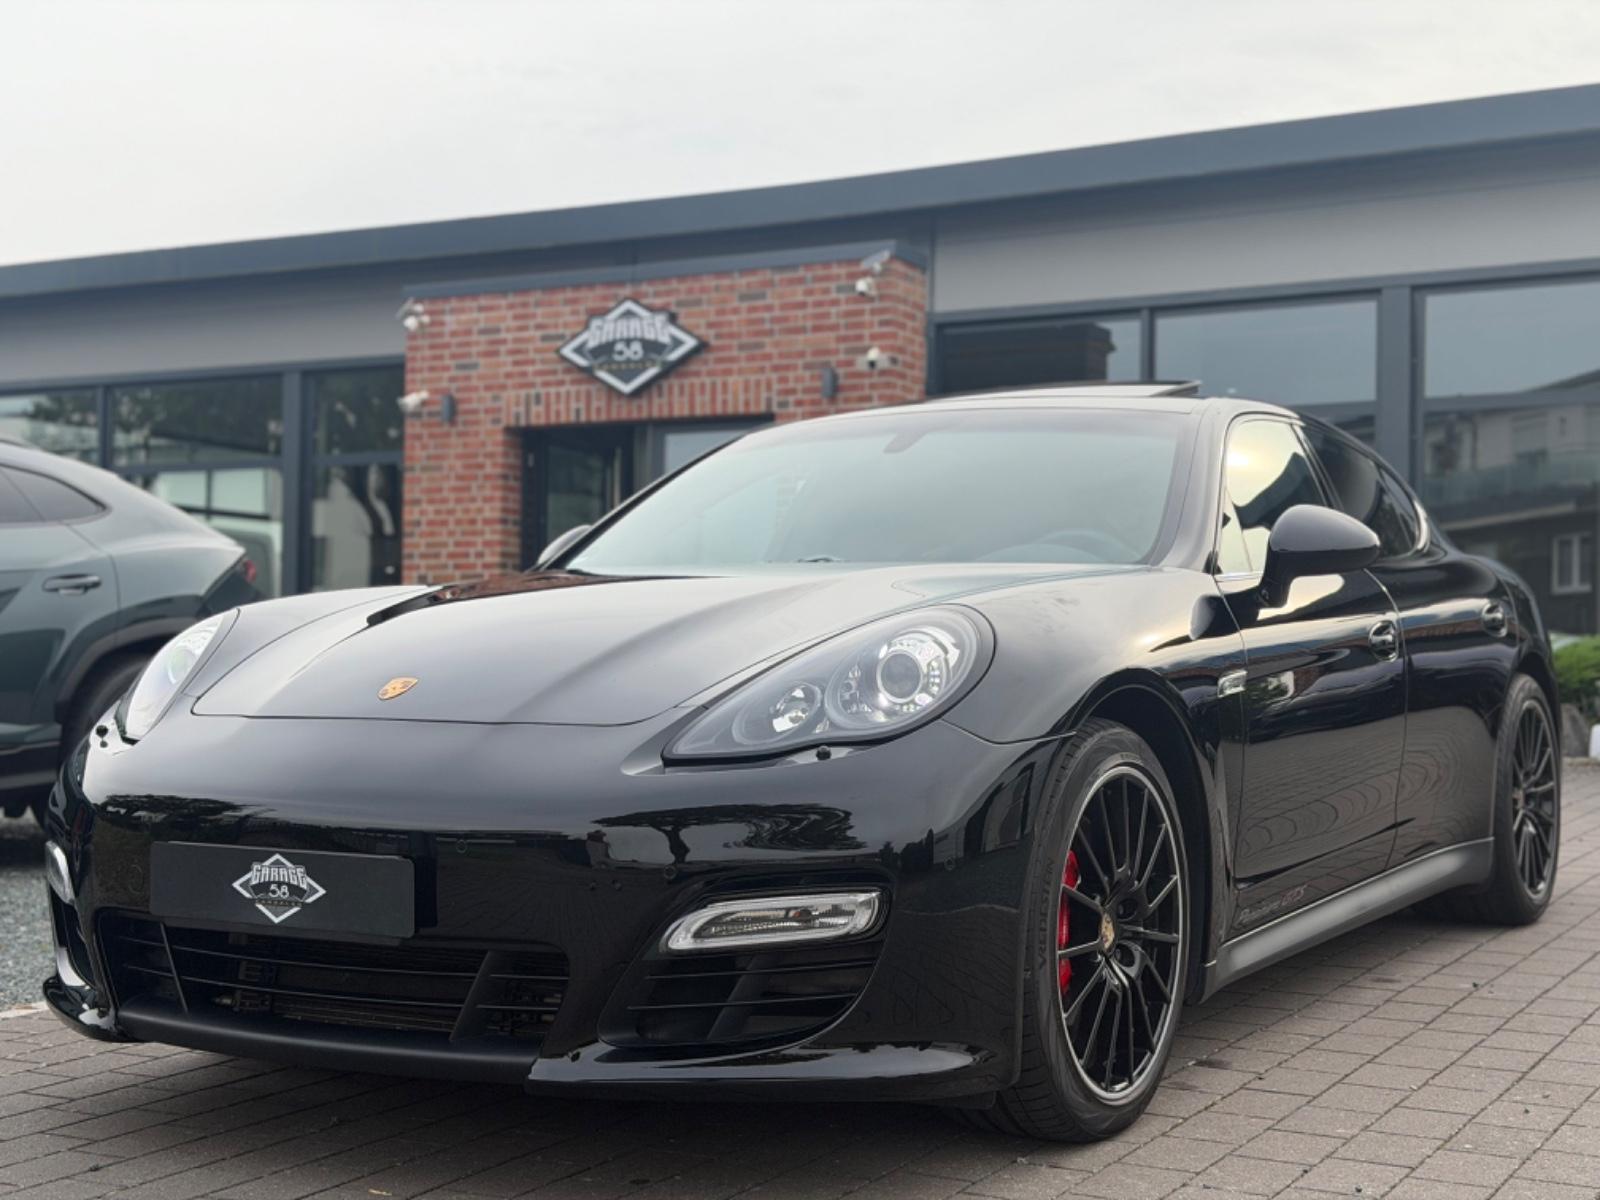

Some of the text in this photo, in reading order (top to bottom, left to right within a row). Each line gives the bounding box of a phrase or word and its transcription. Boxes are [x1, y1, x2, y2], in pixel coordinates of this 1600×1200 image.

[587, 313, 672, 348] GARAGE
[612, 340, 645, 361] 58
[250, 864, 308, 889] GARAGE
[269, 884, 289, 898] 58
